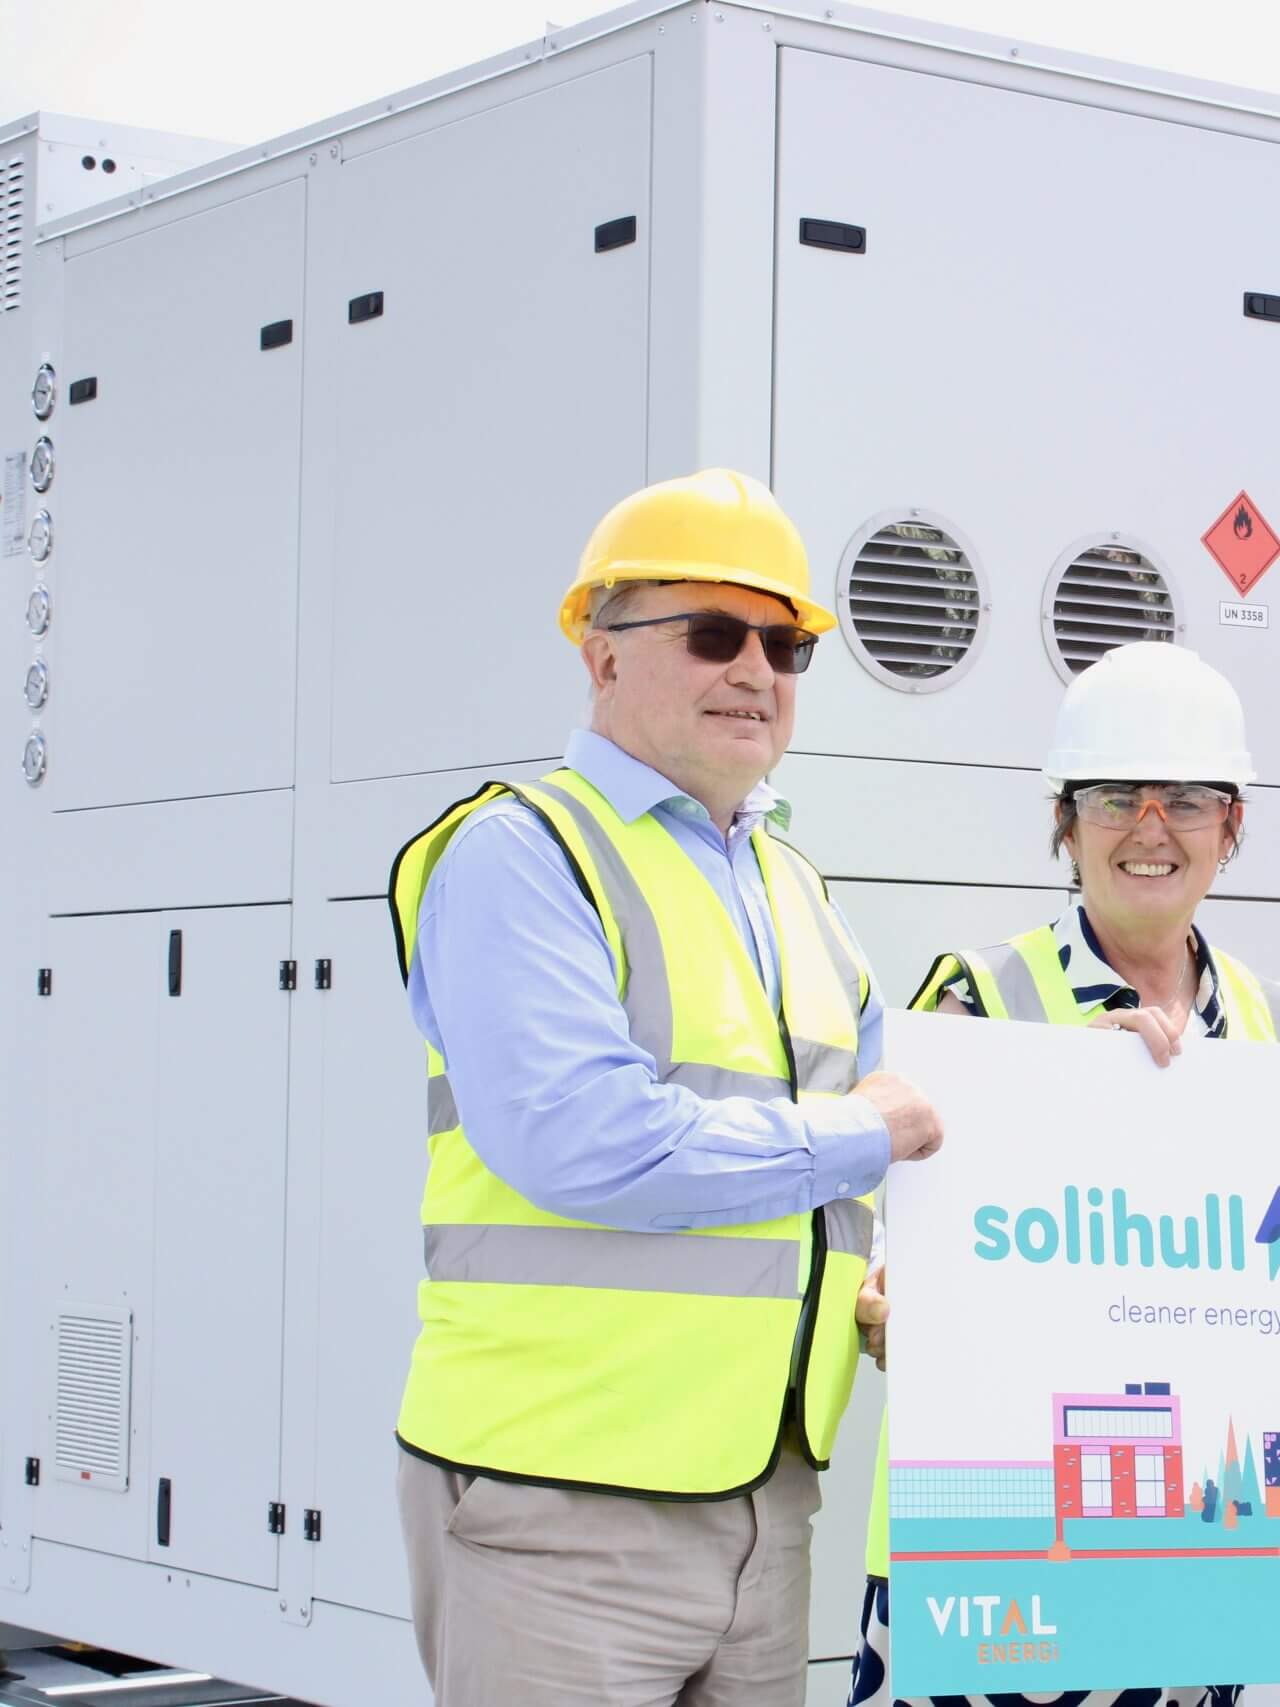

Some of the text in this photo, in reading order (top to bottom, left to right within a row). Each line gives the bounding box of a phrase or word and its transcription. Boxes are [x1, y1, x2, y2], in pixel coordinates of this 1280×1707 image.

[1240, 573, 1247, 584] 2
[1224, 608, 1263, 622] UN 3358
[973, 1184, 1246, 1272] solihull
[1107, 1295, 1197, 1325] cleaner
[926, 1594, 1058, 1637] VITAL
